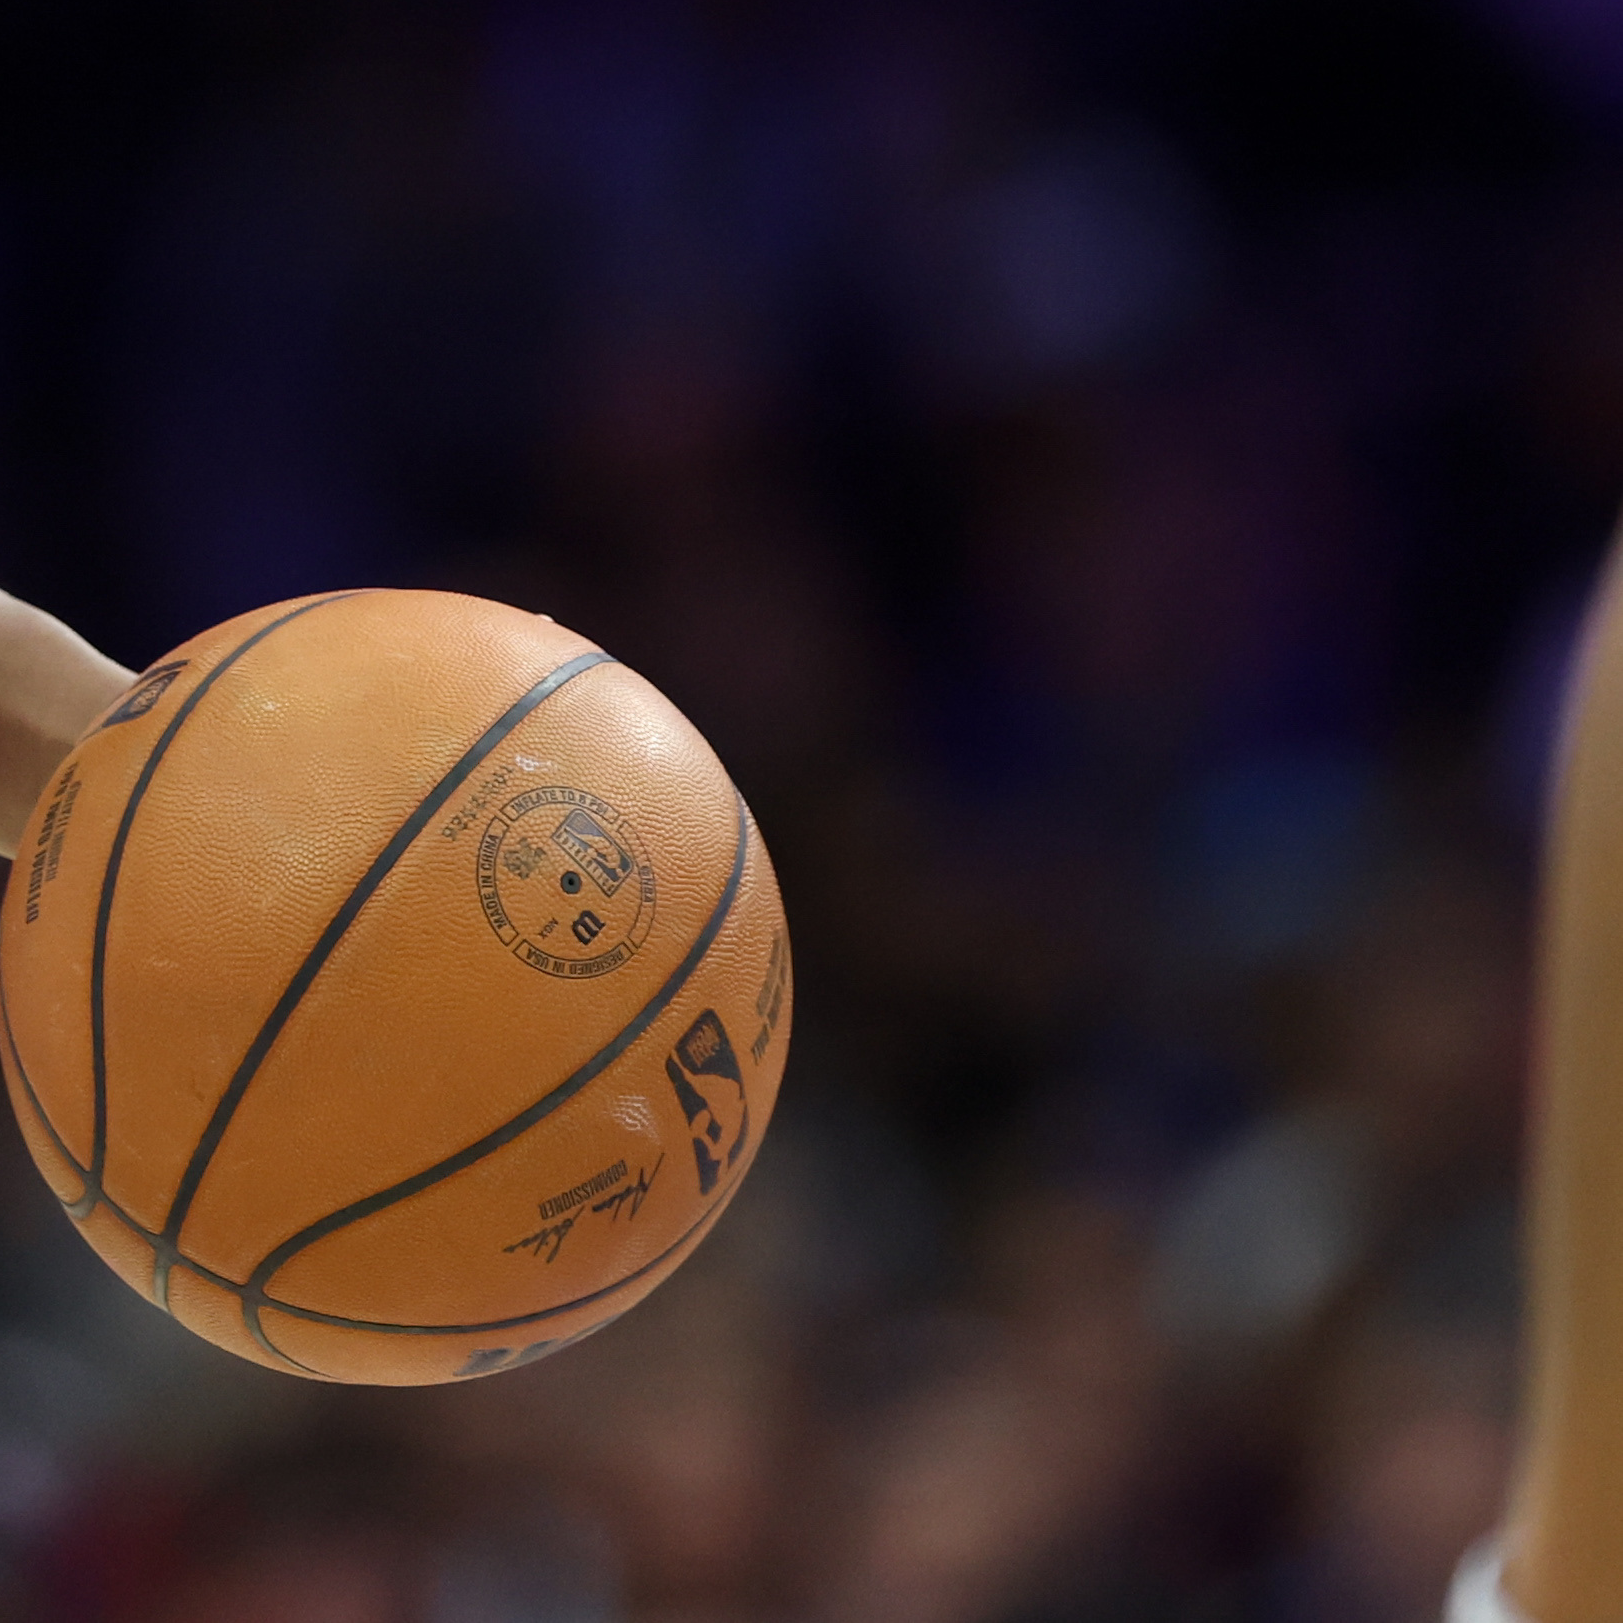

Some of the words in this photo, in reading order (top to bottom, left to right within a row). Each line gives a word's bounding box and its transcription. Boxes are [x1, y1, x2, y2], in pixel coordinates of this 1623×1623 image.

[512, 789, 557, 816] INFLATE
[559, 789, 575, 802] TO
[481, 833, 500, 870] CHINA
[481, 875, 496, 889] IN
[482, 891, 508, 931] MADE
[526, 947, 550, 972] USA
[552, 961, 566, 974] IN
[569, 949, 625, 976] DESIGNED
[538, 1159, 628, 1220] COMMISSIONER
